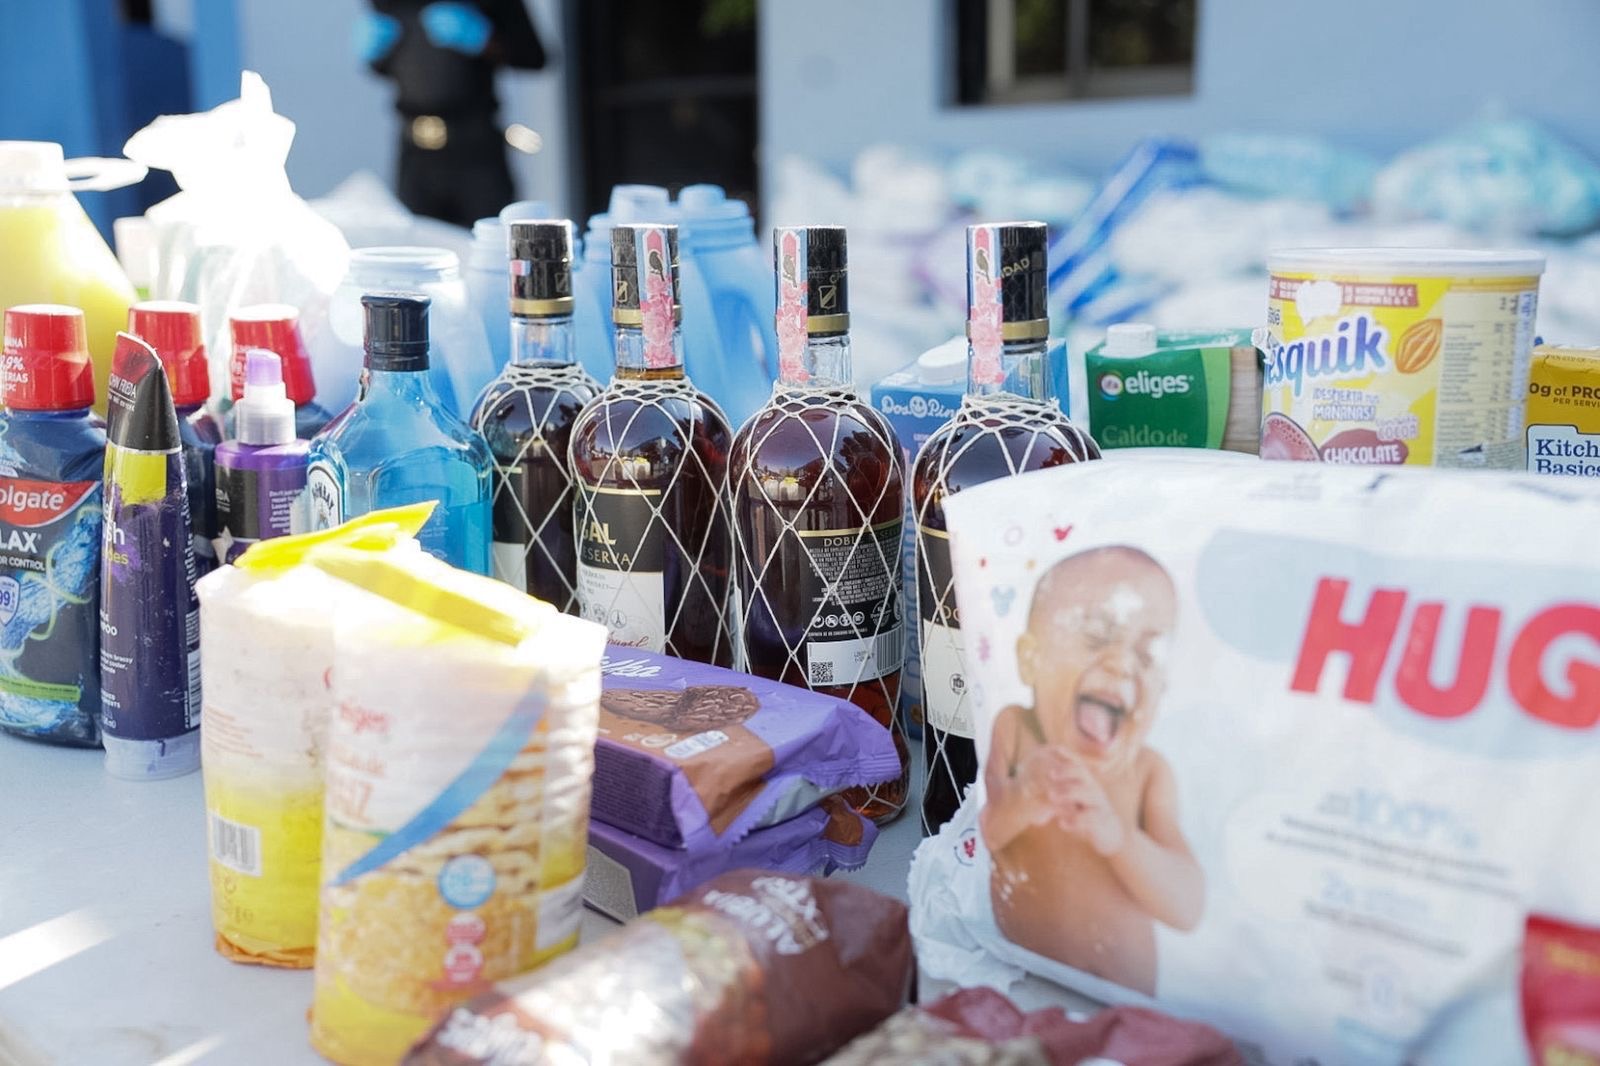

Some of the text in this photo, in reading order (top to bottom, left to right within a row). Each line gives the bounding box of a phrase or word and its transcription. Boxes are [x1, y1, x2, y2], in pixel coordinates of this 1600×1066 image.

[1125, 370, 1190, 399] eliges
[1554, 386, 1567, 396] of
[1553, 396, 1571, 405] PER
[1101, 424, 1188, 446] Caldo de
[1323, 444, 1402, 465] CHOCOLATE
[823, 536, 862, 548] DOBL
[9, 556, 45, 571] CONTROL
[1290, 576, 1600, 730] HUG
